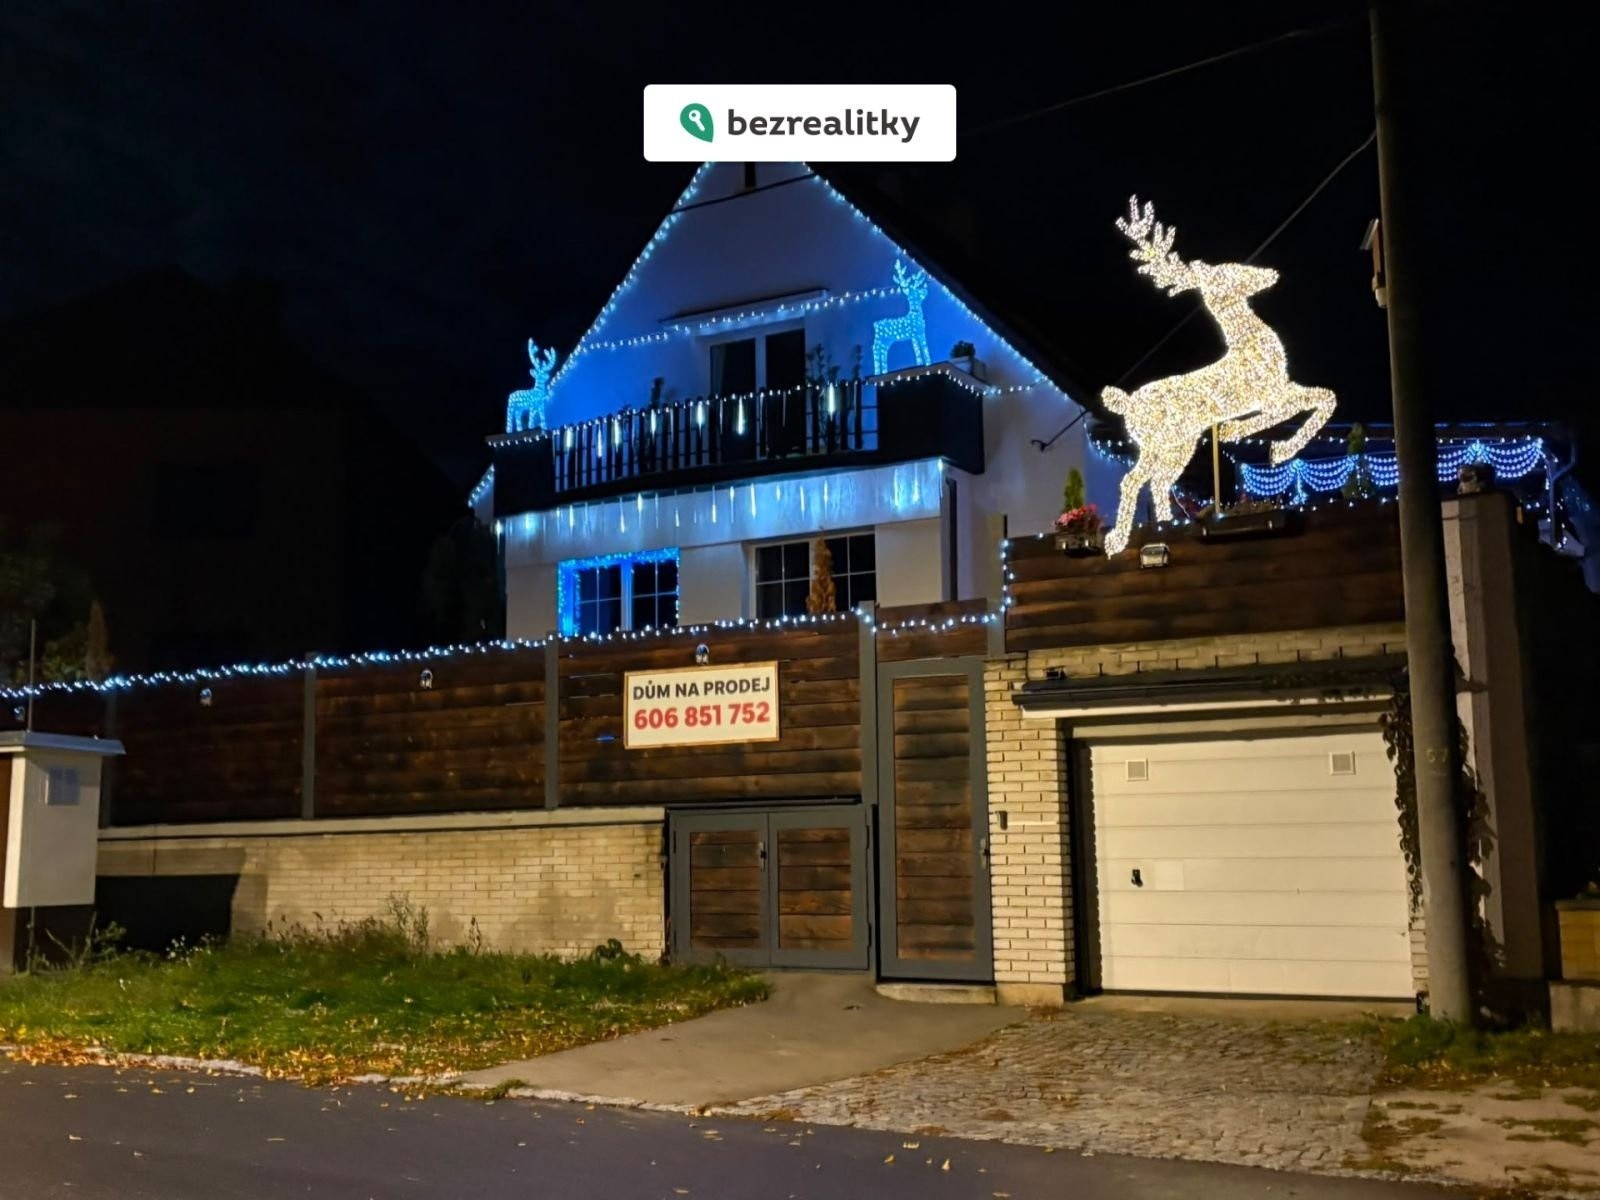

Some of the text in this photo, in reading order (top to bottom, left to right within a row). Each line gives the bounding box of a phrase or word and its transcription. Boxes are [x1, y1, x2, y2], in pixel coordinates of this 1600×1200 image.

[633, 676, 770, 700] DŮM NA PRODEJ
[634, 701, 770, 730] 606 851 752
